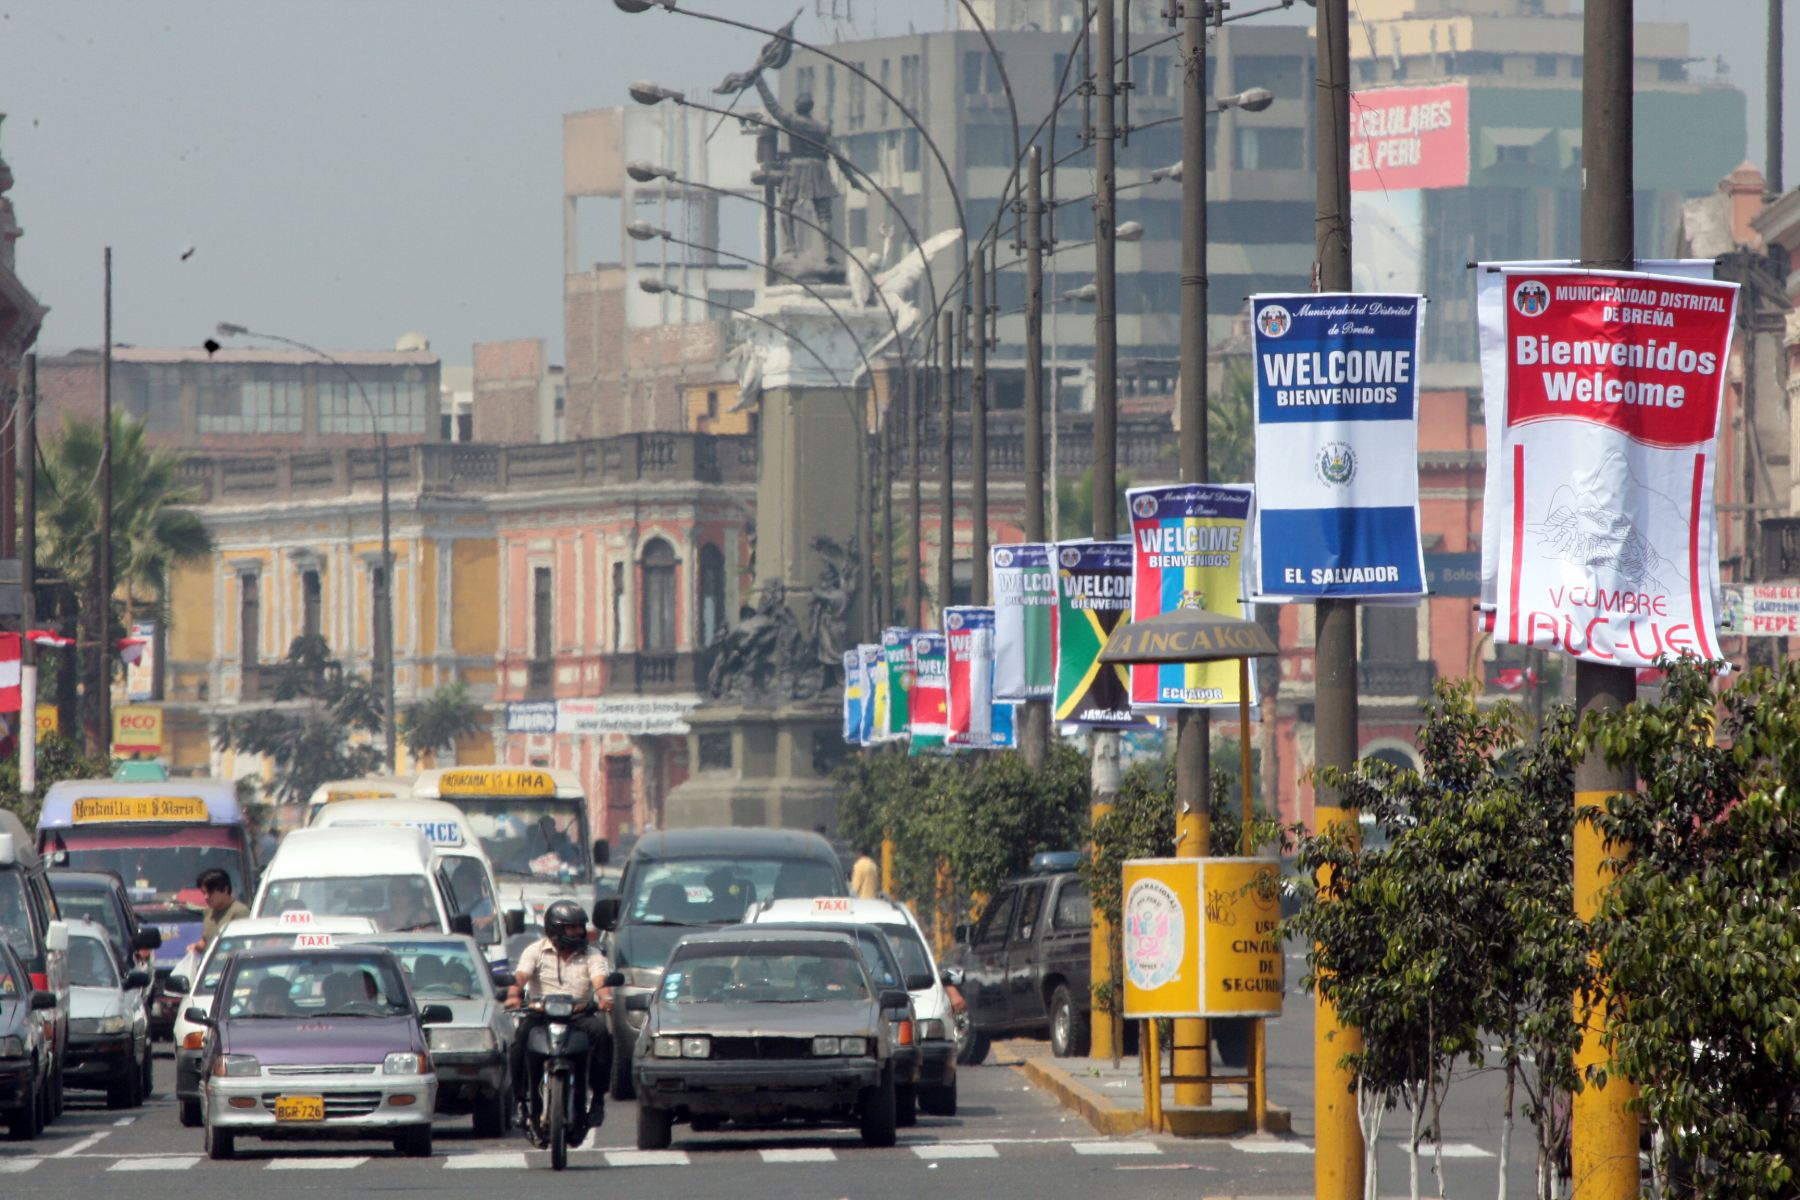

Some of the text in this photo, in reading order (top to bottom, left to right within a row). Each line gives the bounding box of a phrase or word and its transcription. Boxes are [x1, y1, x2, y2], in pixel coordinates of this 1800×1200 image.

[1556, 286, 1726, 313] MUNICIPALIDAD DISTRITAL
[1293, 302, 1415, 318] Municipalidad Distrital
[1603, 306, 1674, 327] DE BREÑA
[1327, 322, 1375, 336] de Breña
[1516, 335, 1717, 375] Bienvenidos
[1263, 351, 1410, 387] WELCOME
[1276, 387, 1397, 406] BIENVENIDOS
[1542, 372, 1685, 409] Welcome
[1139, 527, 1241, 553] WELCOME
[1149, 554, 1231, 568] BIENVENIDOS
[999, 573, 1052, 592] WELCO
[1285, 566, 1399, 585] EL SALVADOR
[1071, 597, 1131, 610] BIENVENID
[1549, 586, 1667, 616] V CUMBRE
[1162, 687, 1223, 700] ECUADOR
[1080, 708, 1132, 721] JAMAICA
[507, 774, 544, 788] LIMA
[816, 899, 848, 912] TAXI
[284, 913, 311, 924] TAXI
[300, 935, 330, 946] TAXI
[1259, 960, 1274, 974] DE
